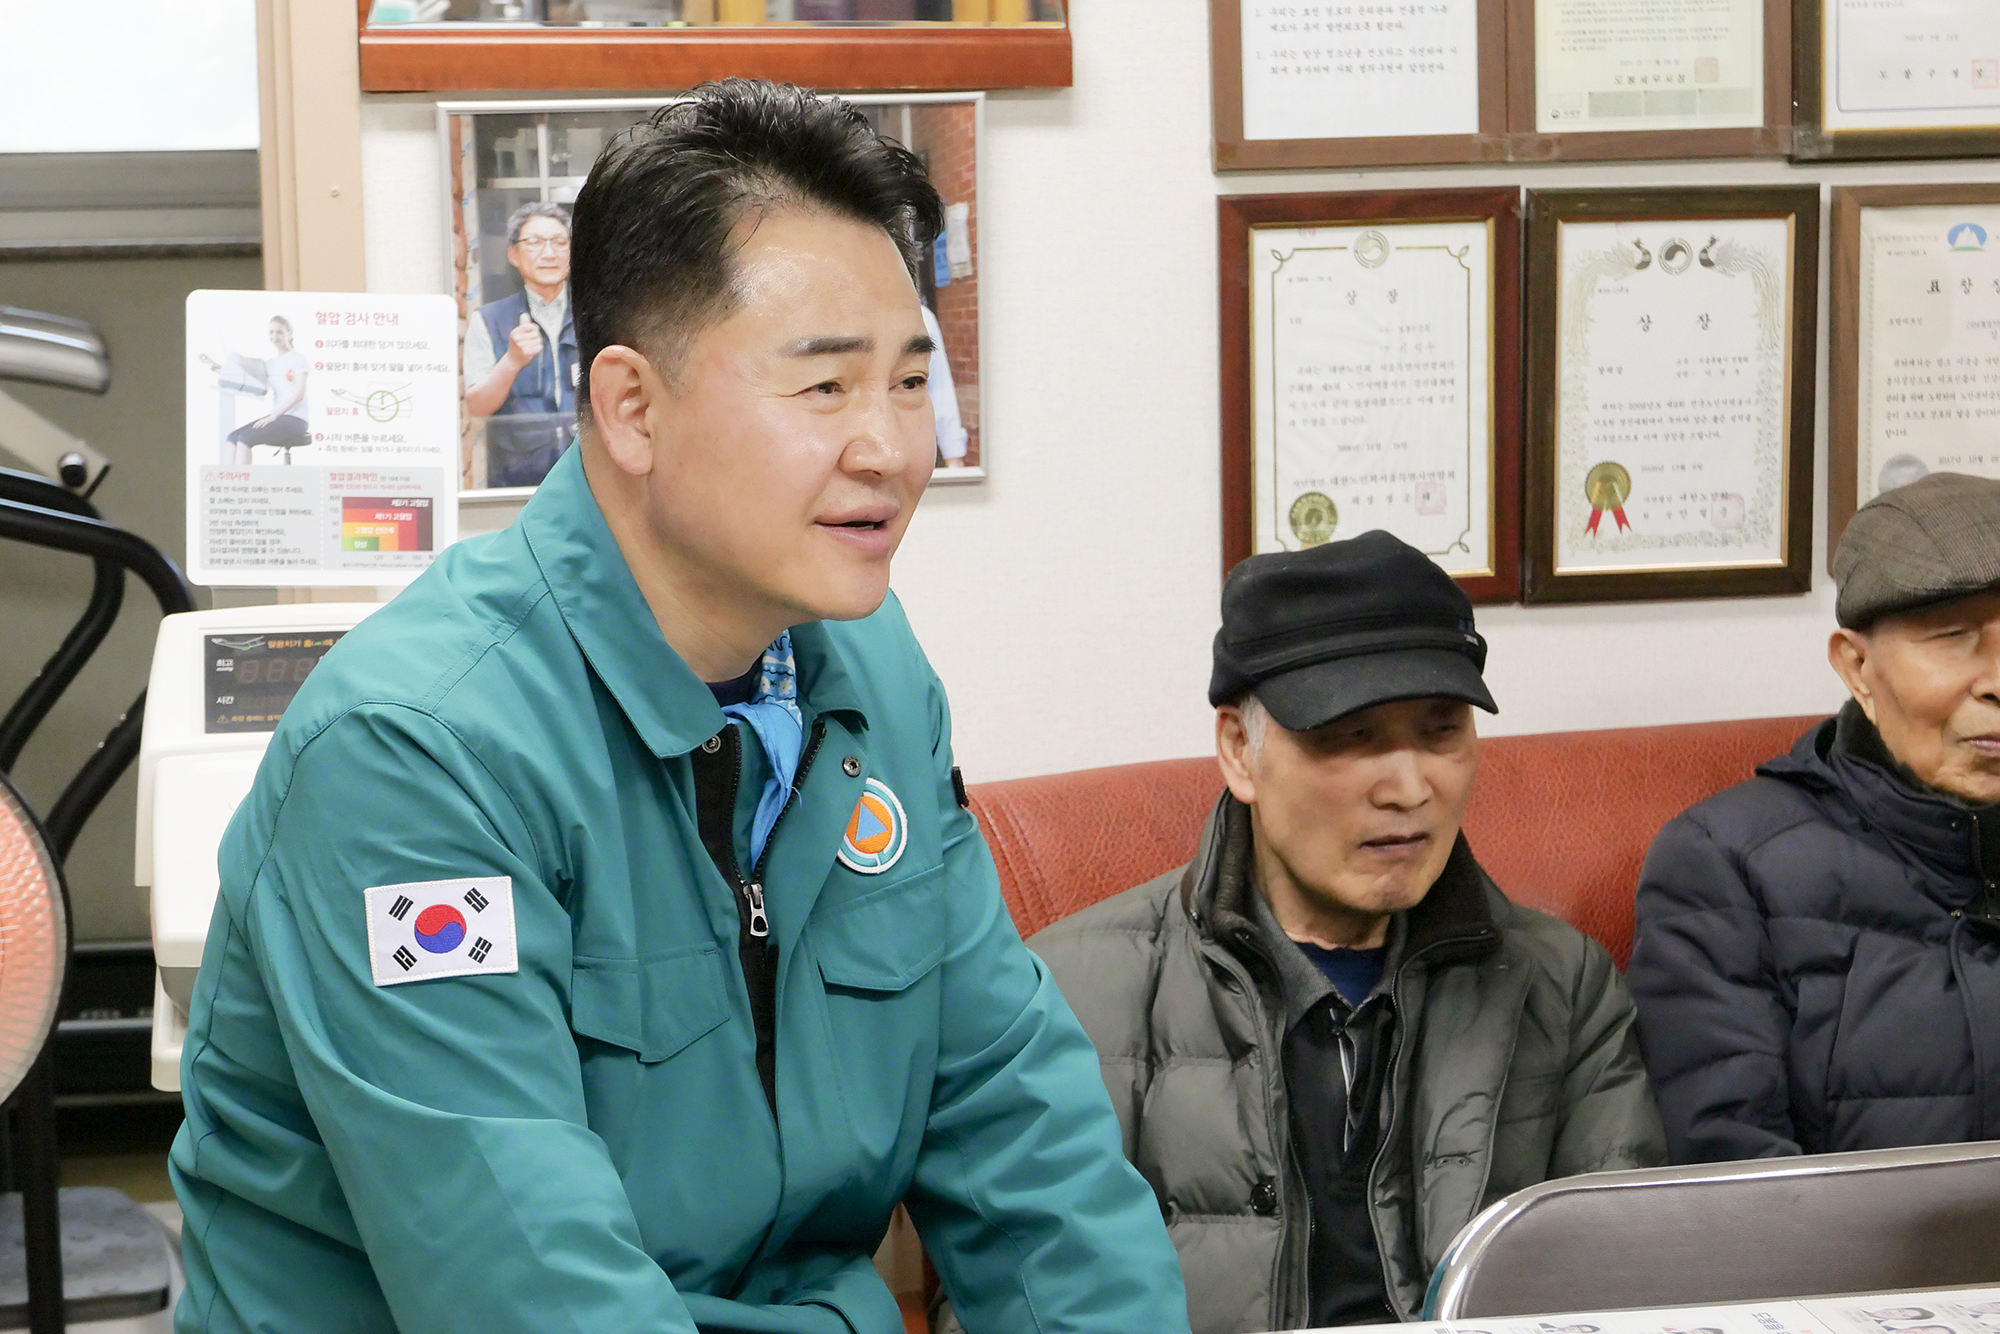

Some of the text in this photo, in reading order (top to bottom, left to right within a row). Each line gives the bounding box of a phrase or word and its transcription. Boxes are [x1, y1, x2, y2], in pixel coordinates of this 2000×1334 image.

[316, 312, 399, 326] 혈압 검사 안내
[1636, 312, 1712, 333] 상 장
[326, 340, 349, 349] 의자를
[353, 340, 376, 349] 최대한
[326, 362, 350, 372] 팔꿈치
[353, 363, 368, 372] 홈에
[389, 363, 404, 372] 팔을
[326, 408, 359, 416] 팔꿈치 홈
[326, 434, 406, 443] 시작 버튼을 누르세요.
[218, 472, 250, 481] 주의사항
[268, 640, 301, 649] 팔꿈치가
[216, 659, 234, 667] 최고
[216, 696, 235, 705] 시간
